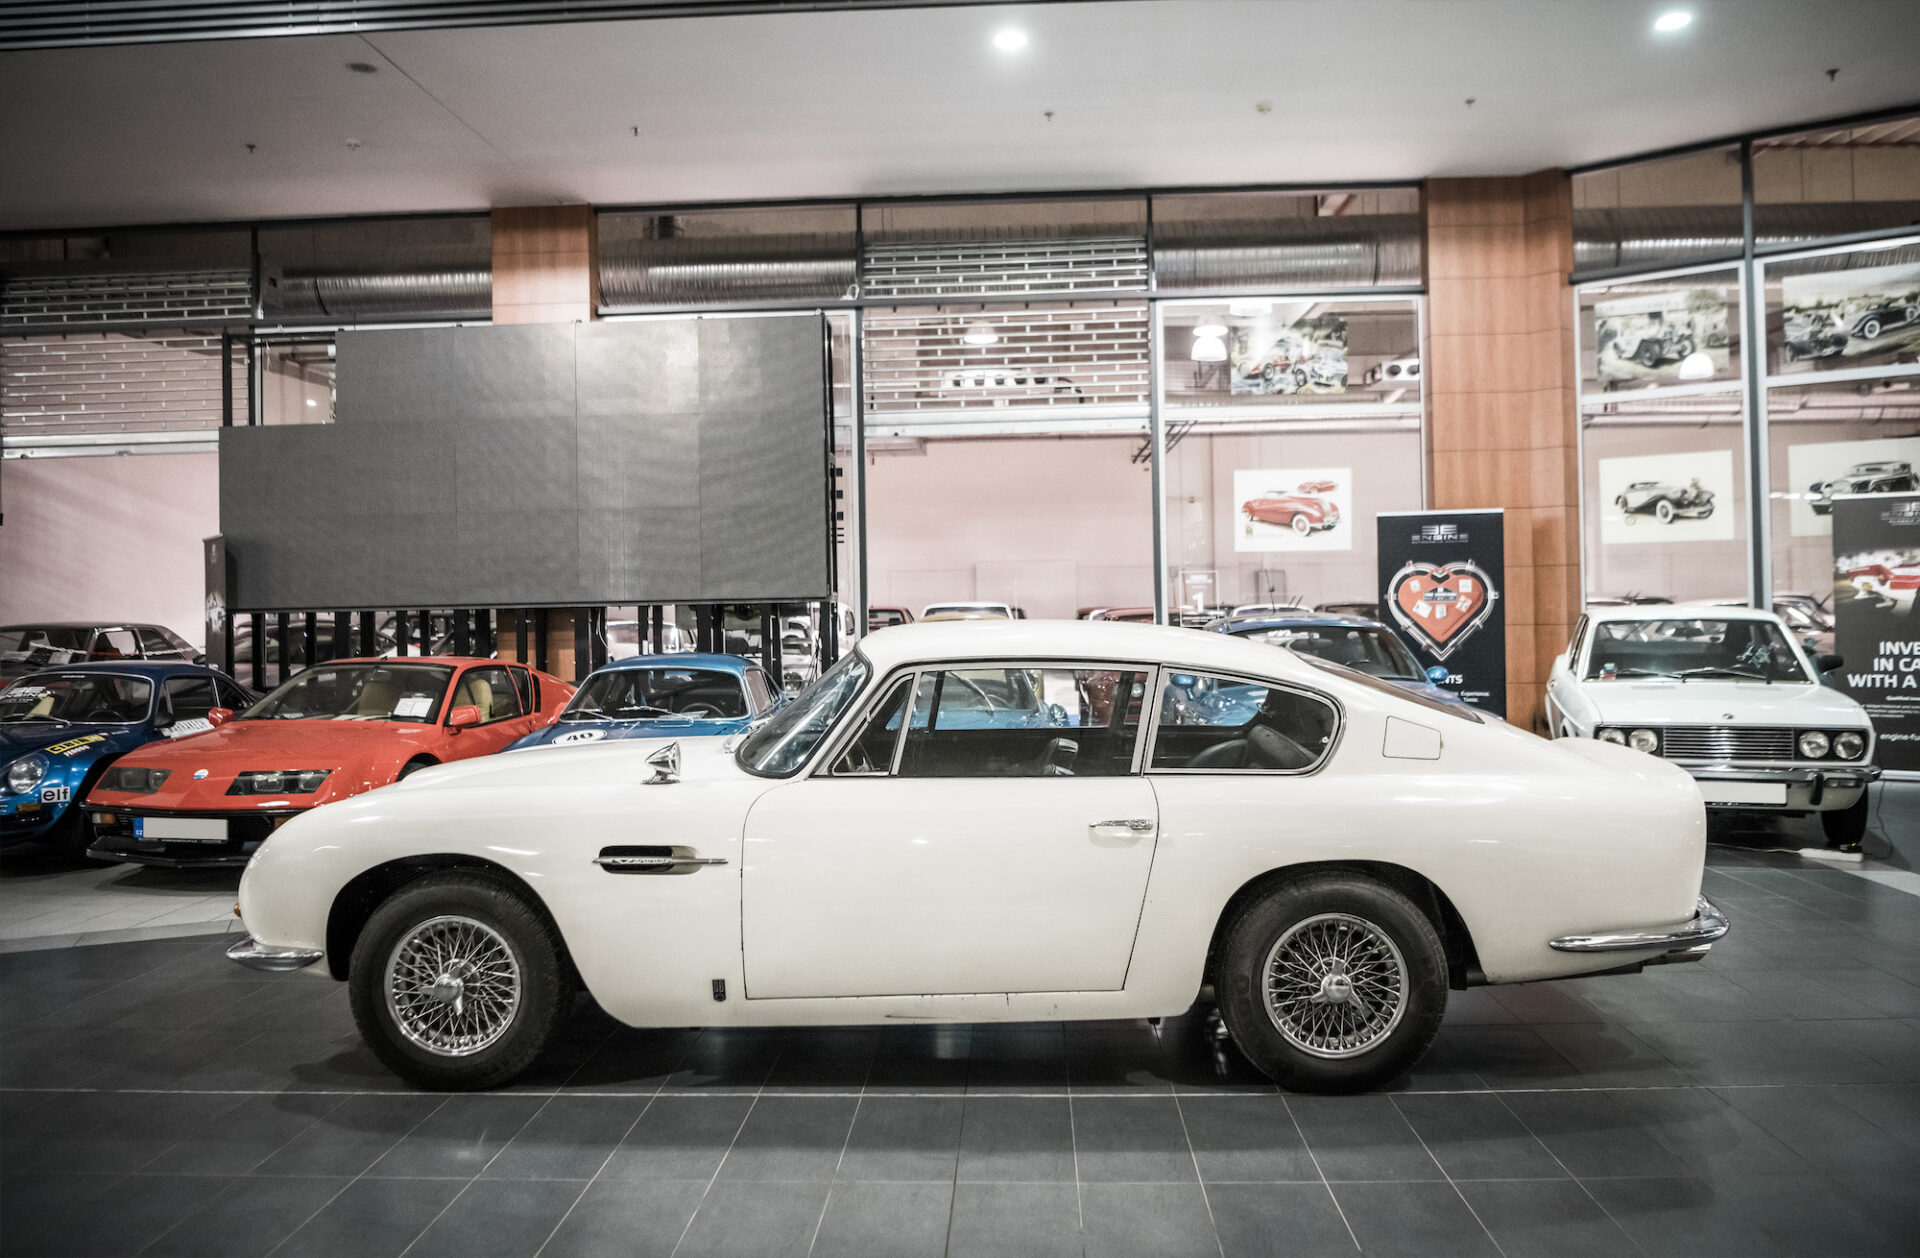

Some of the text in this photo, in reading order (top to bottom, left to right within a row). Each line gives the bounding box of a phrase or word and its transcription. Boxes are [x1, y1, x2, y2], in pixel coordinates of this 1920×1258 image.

[1879, 641, 1920, 655] INVE
[1873, 657, 1920, 672] IN CA
[1441, 674, 1464, 685] NTS
[1847, 673, 1918, 689] WITH A
[43, 788, 69, 801] elf
